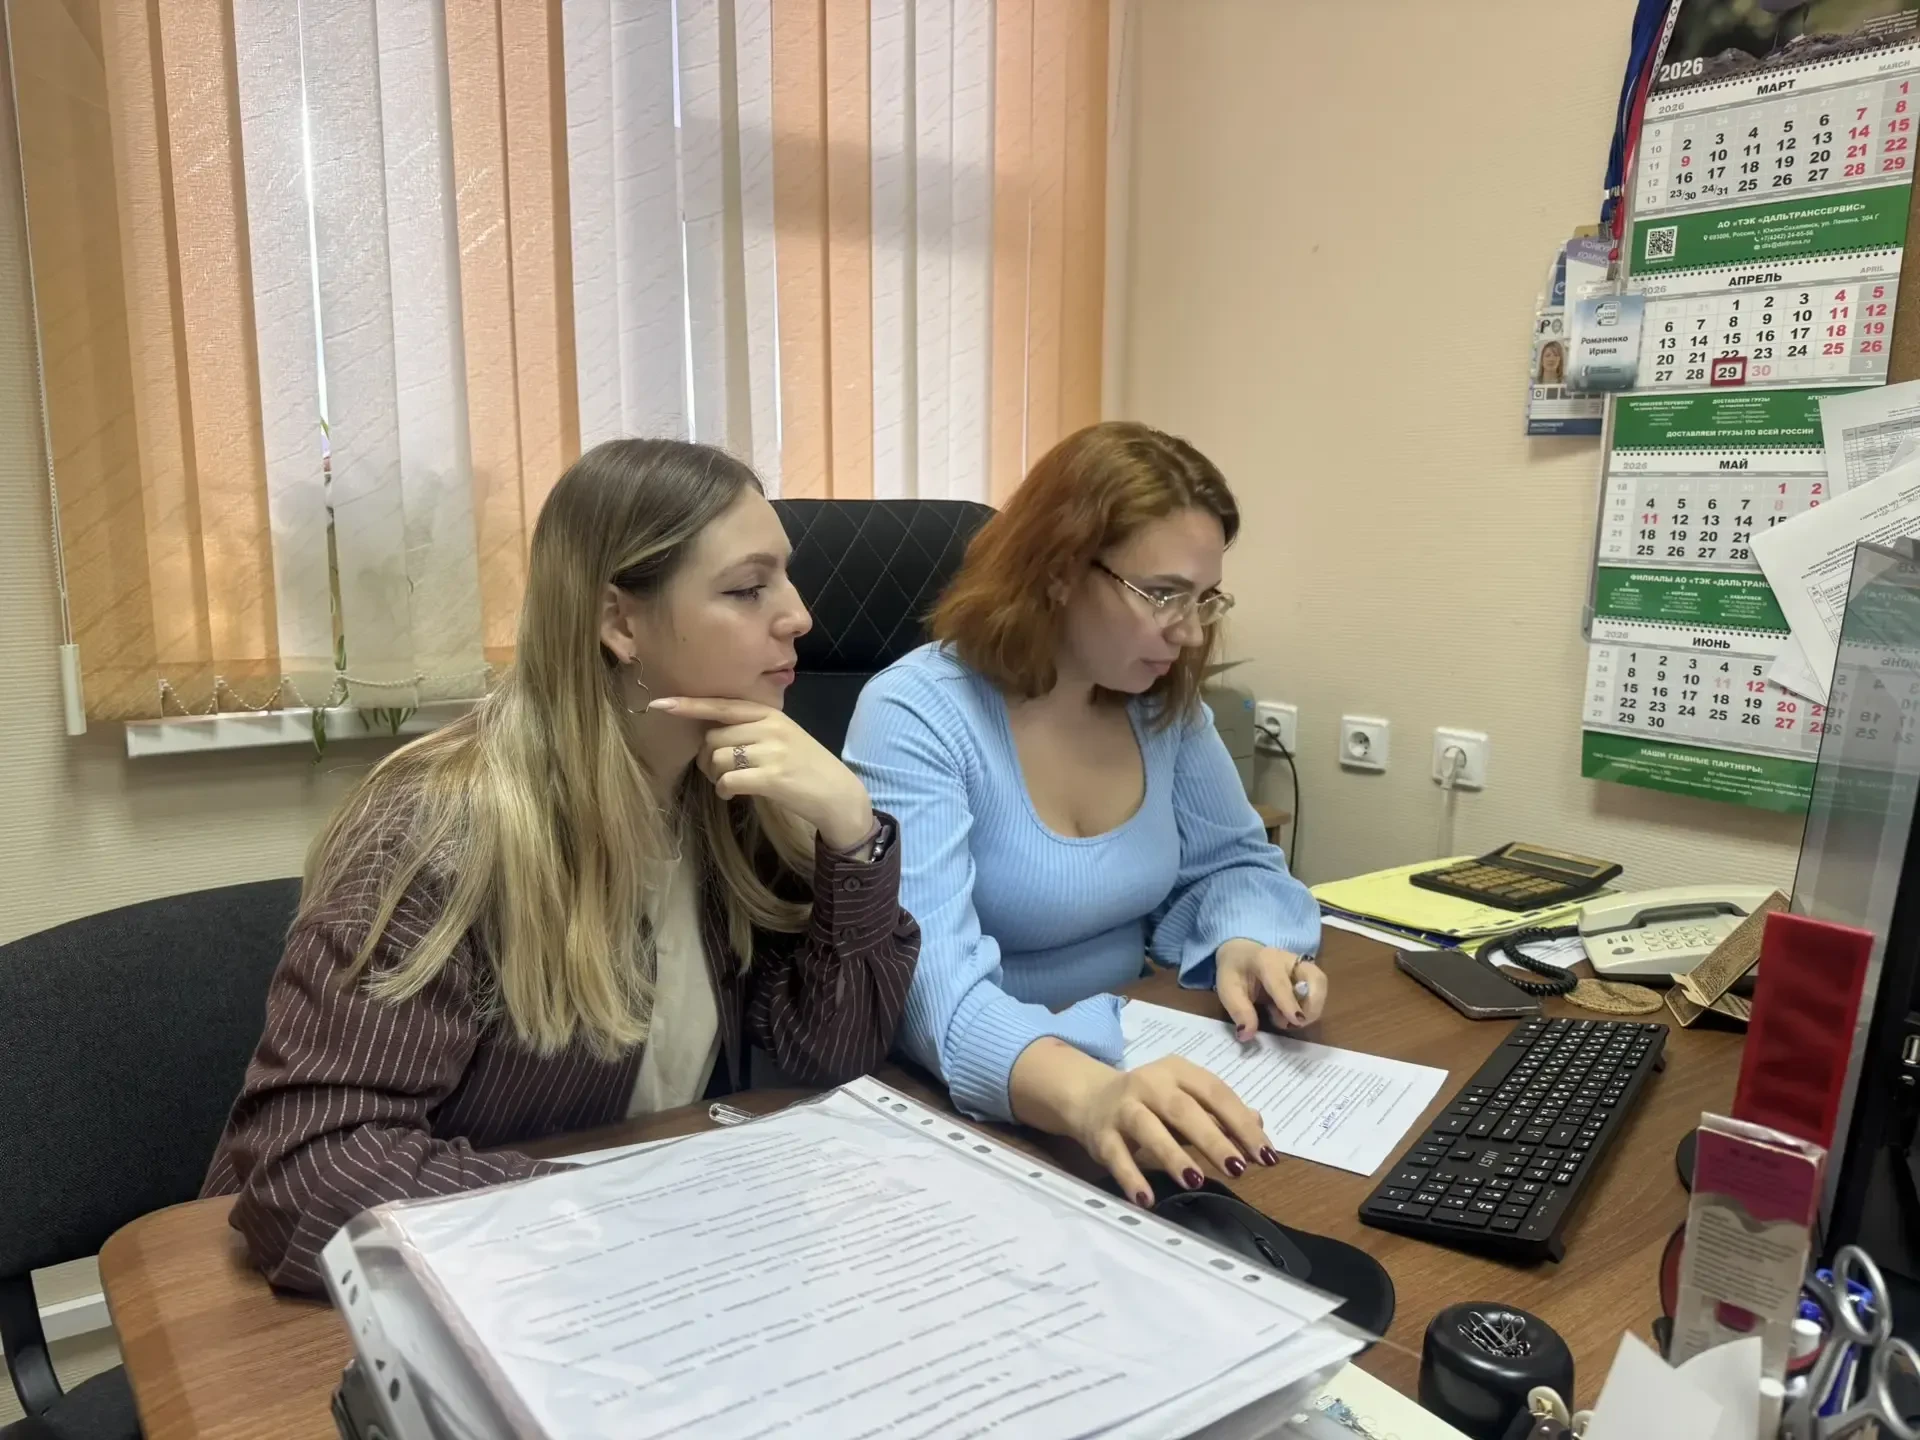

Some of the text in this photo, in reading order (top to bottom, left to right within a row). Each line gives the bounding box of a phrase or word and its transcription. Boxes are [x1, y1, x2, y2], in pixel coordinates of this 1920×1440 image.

[1659, 57, 1703, 82] 2026
[1878, 60, 1911, 73] MARCH
[1757, 79, 1796, 95] МАРТ
[1654, 81, 1908, 137] 9 1
[1658, 103, 1685, 114] 2026
[1651, 100, 1906, 154] 10 2 3 4 5 6 7 8
[1649, 118, 1910, 170] 11 9 10 11 12 13 14 15
[1648, 137, 1907, 187] 12 16 17 18 19 20 21 22
[1670, 157, 1905, 200] 23/30 24/31 25 26 27 28 29
[1717, 203, 1865, 229] АО «ТЭК «ДАЛЬТРАНССЕРВИС»
[1860, 265, 1884, 274] APRIL
[1728, 273, 1782, 286] АПРЕЛЬ
[1641, 284, 1667, 295] 2026
[1732, 286, 1884, 311] 1 2 3 4 5
[1665, 304, 1887, 332] 6 7 8 9 10 11 12
[1581, 336, 1628, 344] Романенко
[1659, 322, 1885, 349] 13 14 15 16 17 18 19
[1589, 348, 1617, 356] Ирина
[1657, 354, 1674, 365] 20
[1688, 352, 1705, 363] 21
[1753, 347, 1772, 359] 23
[1787, 345, 1807, 357] 24
[1822, 342, 1844, 355] 25
[1860, 340, 1882, 353] 26
[1655, 365, 1771, 381] 27 28 29 30
[1666, 430, 1715, 438] ДОСТАВЛЯЕМ
[1623, 462, 1647, 470] 2026
[1719, 458, 1748, 469] МАЙ
[1778, 483, 1822, 494] 1 2
[1646, 498, 1655, 508] 4
[1677, 498, 1686, 509] 5
[1708, 499, 1717, 509] 6
[1741, 499, 1750, 510] 7
[1642, 513, 1658, 524] 11
[1672, 514, 1689, 525] 12
[1702, 515, 1720, 526] 13
[1735, 516, 1752, 526] 14
[1640, 529, 1750, 543] 18 19 20 21
[1637, 545, 1749, 560] 25 26 27 28
[1630, 574, 1671, 582] ФИЛИАЛЫ
[1689, 577, 1711, 585] «ТЭК
[1604, 630, 1628, 639] 2026
[1693, 637, 1730, 649] ИЮНЬ
[1630, 653, 1762, 676] 1 2 3 4 5
[1627, 667, 1765, 693] 8 9 10 11 12
[1623, 683, 1796, 713] 15 16 17 18 19 20
[1618, 712, 1664, 728] 29 30
[1620, 697, 1795, 729] 22 23 24 25 26 27
[1641, 749, 1666, 758] НАШИ
[1668, 753, 1709, 765] ГЛАВНЫЕ
